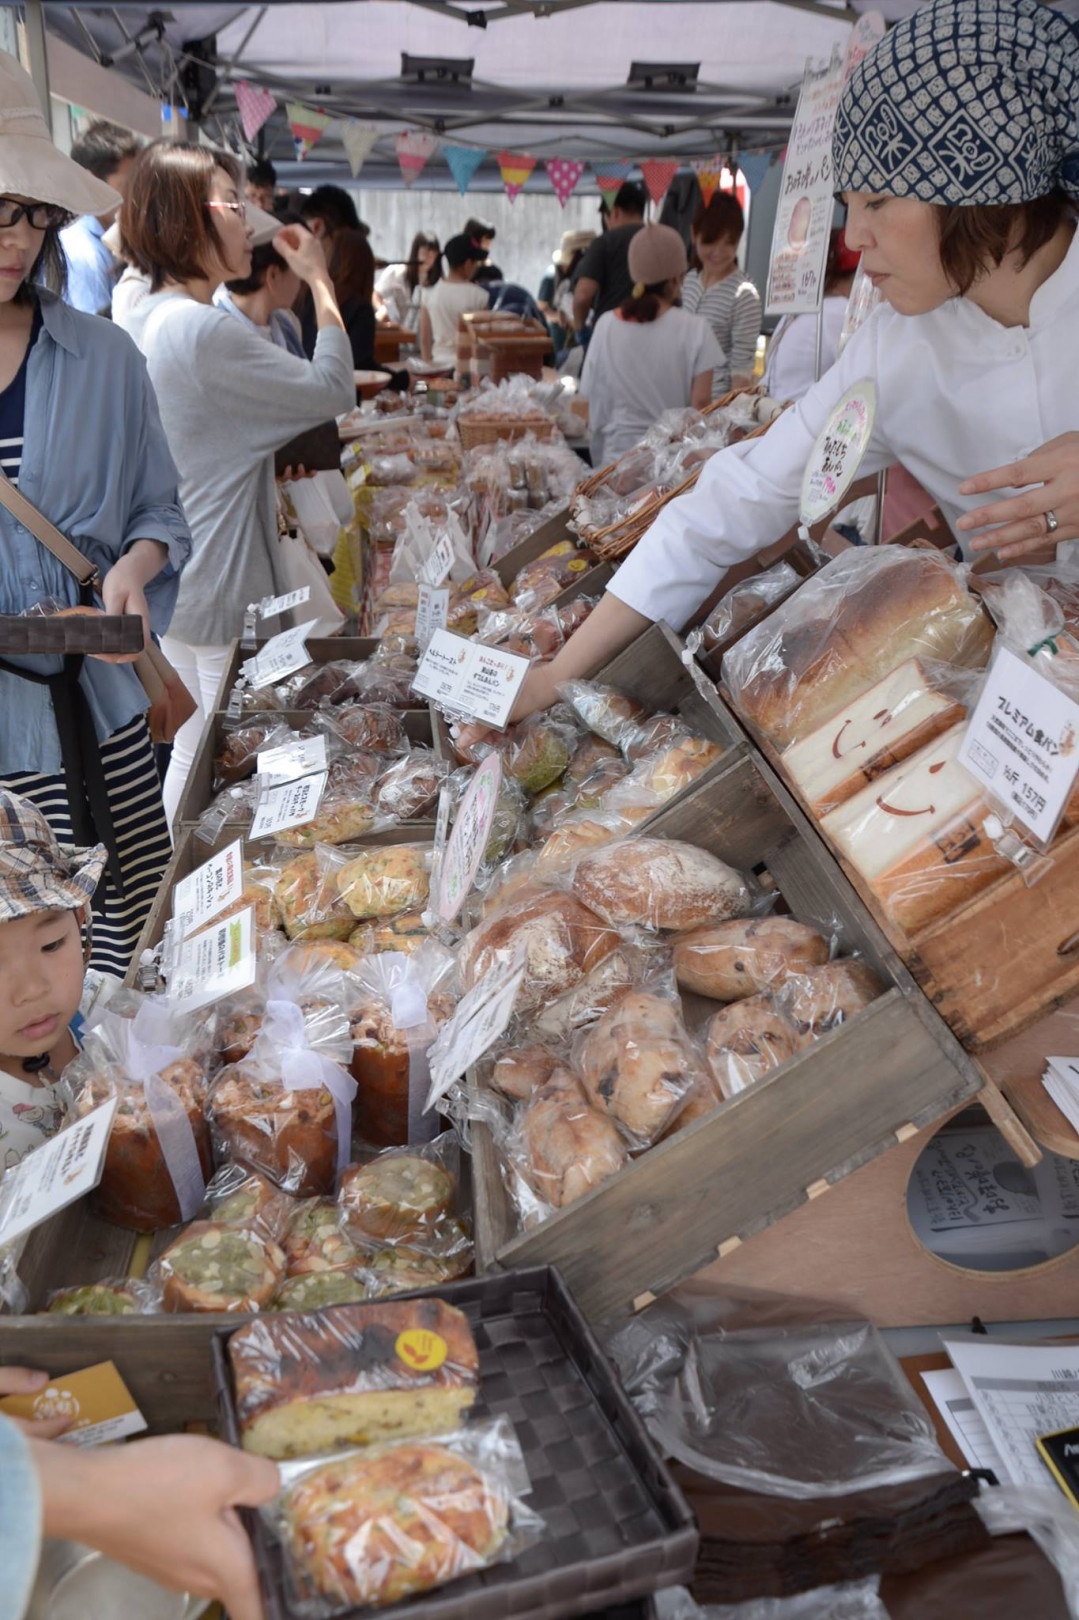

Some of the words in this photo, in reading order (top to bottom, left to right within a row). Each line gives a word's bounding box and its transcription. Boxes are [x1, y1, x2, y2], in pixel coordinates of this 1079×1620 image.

[997, 695, 1059, 756] プレミアム食パン
[1021, 783, 1047, 813] 157円
